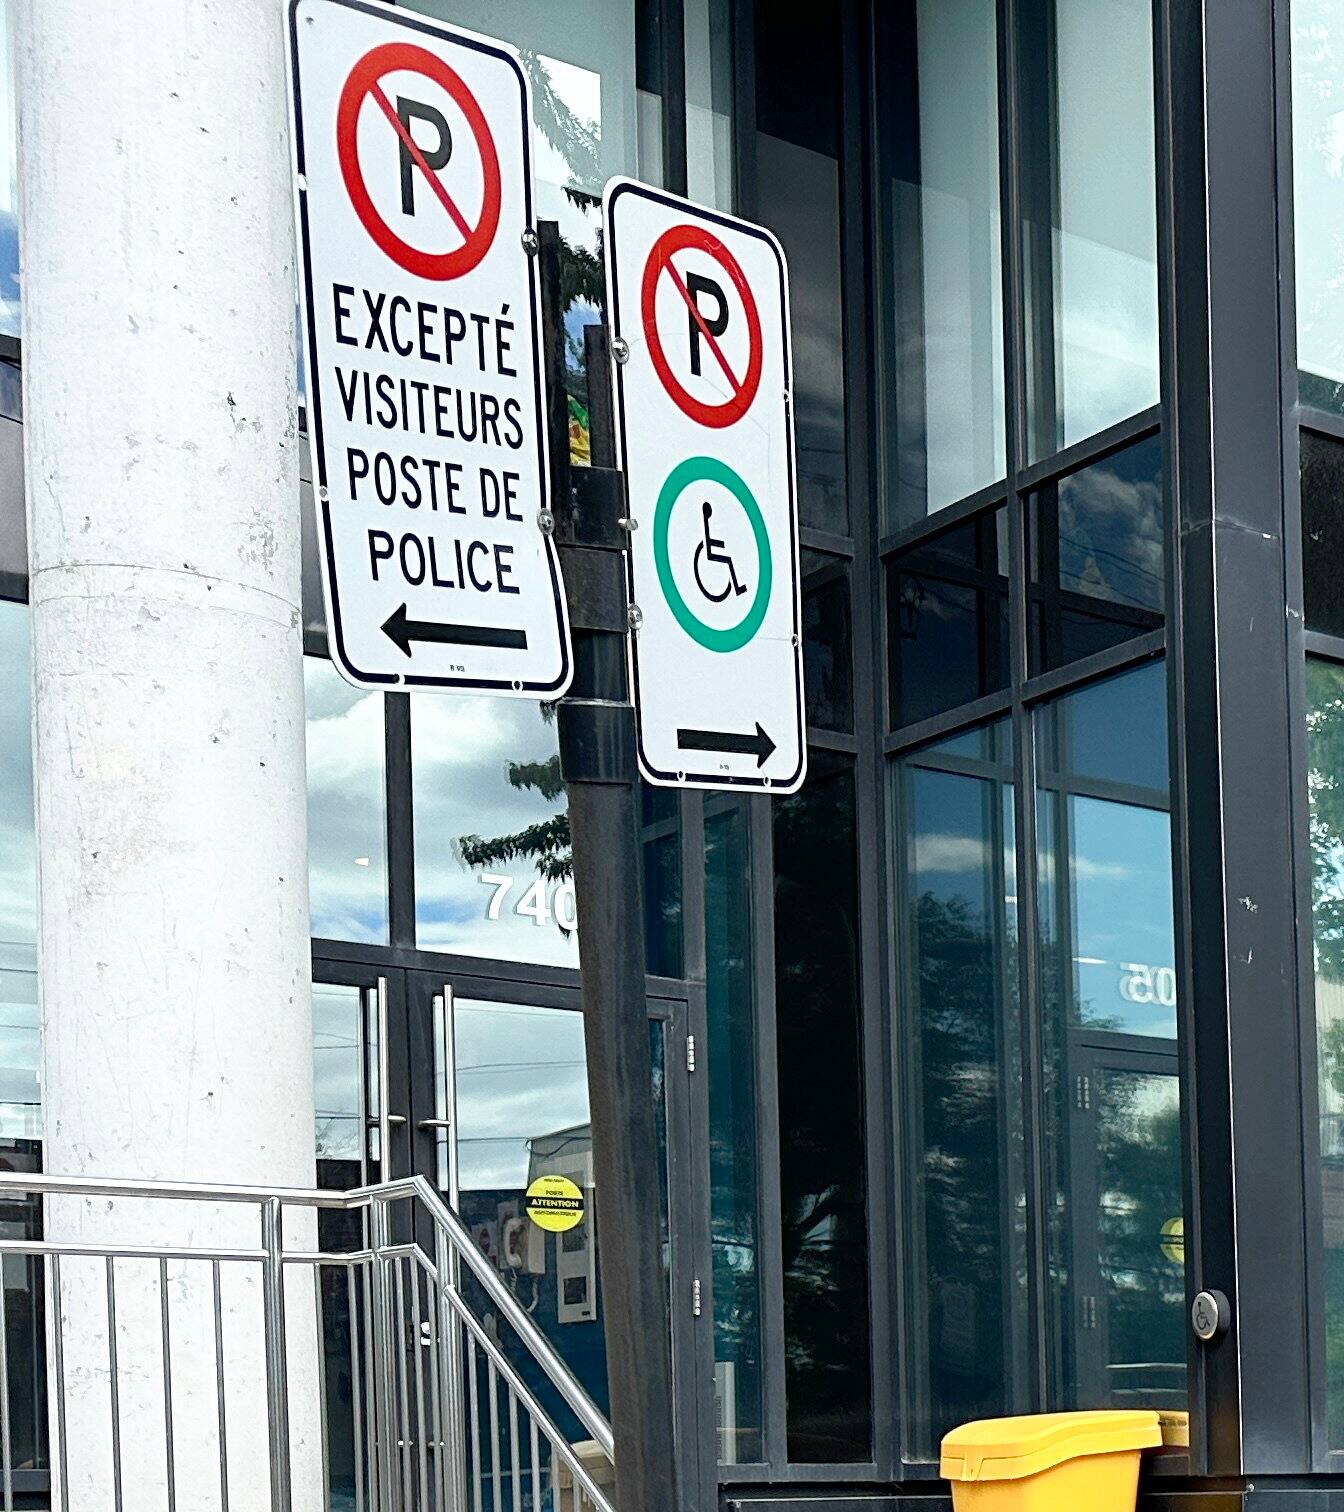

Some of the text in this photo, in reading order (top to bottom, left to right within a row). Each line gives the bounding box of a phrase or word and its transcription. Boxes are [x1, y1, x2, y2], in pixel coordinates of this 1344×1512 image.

[332, 282, 517, 377] EXCEPTÉ
[334, 366, 524, 450] VISITEURS
[347, 446, 524, 522] POSTE DE
[367, 528, 521, 594] POLICE
[478, 872, 578, 931] 740
[531, 1198, 580, 1209] ATTENTION
